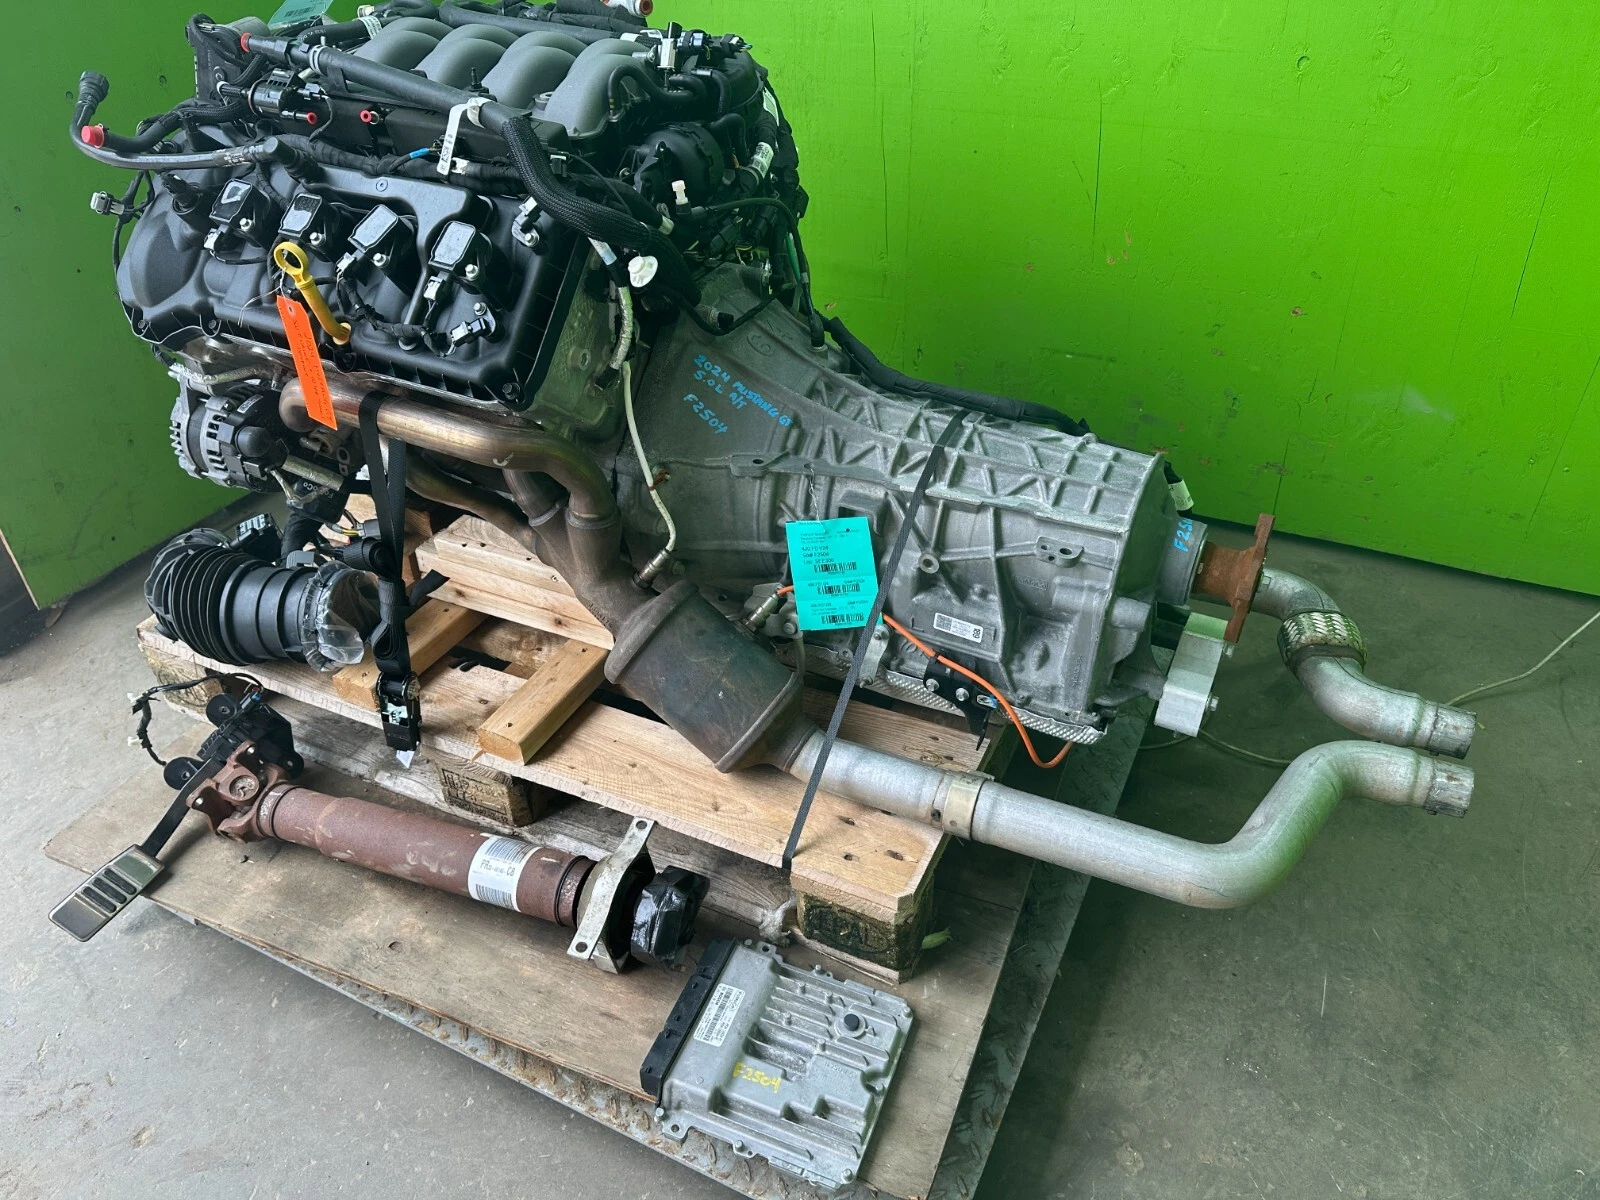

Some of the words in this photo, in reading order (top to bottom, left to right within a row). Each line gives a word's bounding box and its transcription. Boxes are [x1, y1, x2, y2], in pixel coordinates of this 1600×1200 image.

[694, 354, 730, 382] 2024
[732, 381, 779, 417] MUSTANG
[683, 394, 728, 434] F2504
[733, 1061, 781, 1095] F2504
